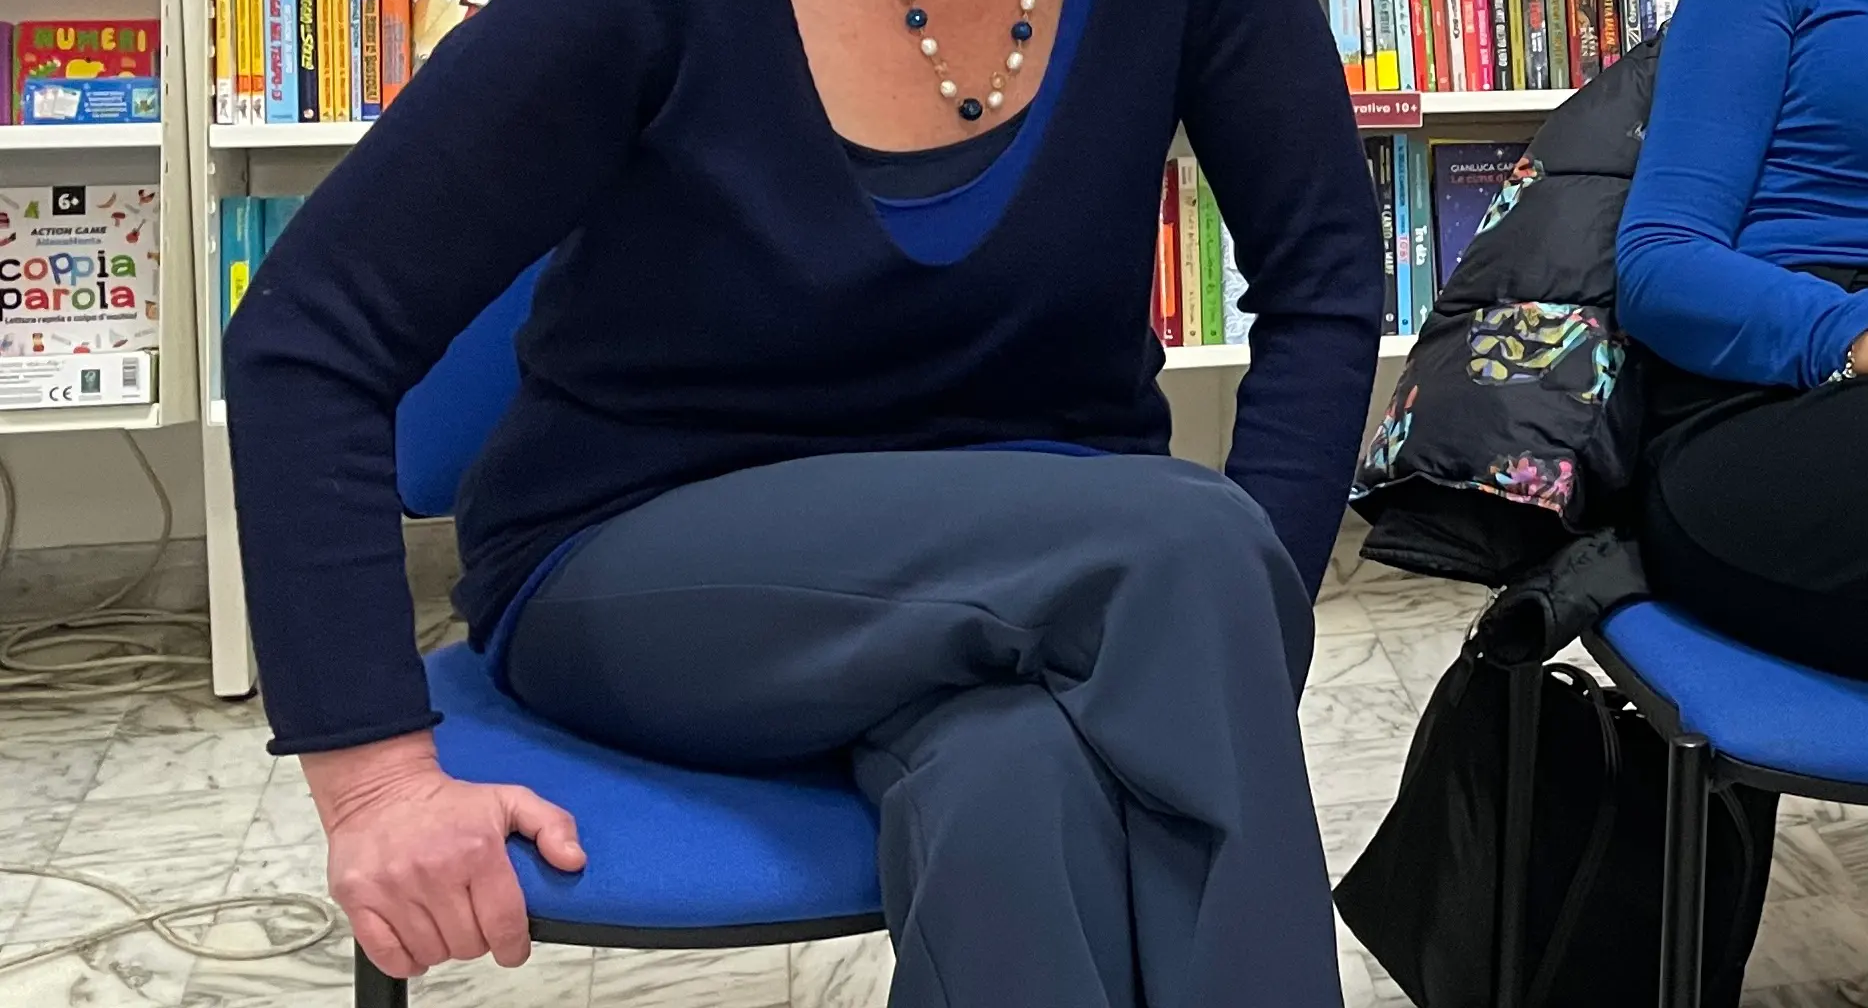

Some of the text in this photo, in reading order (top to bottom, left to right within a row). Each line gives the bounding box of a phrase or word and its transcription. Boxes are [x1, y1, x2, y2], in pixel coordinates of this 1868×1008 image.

[35, 29, 147, 52] NUMERI
[1394, 102, 1418, 114] 10+
[1450, 163, 1495, 173] GIANLUCA
[58, 193, 80, 210] 6+
[30, 226, 107, 236] ACTION GAME
[0, 250, 136, 286] coppia
[0, 282, 135, 321] parola
